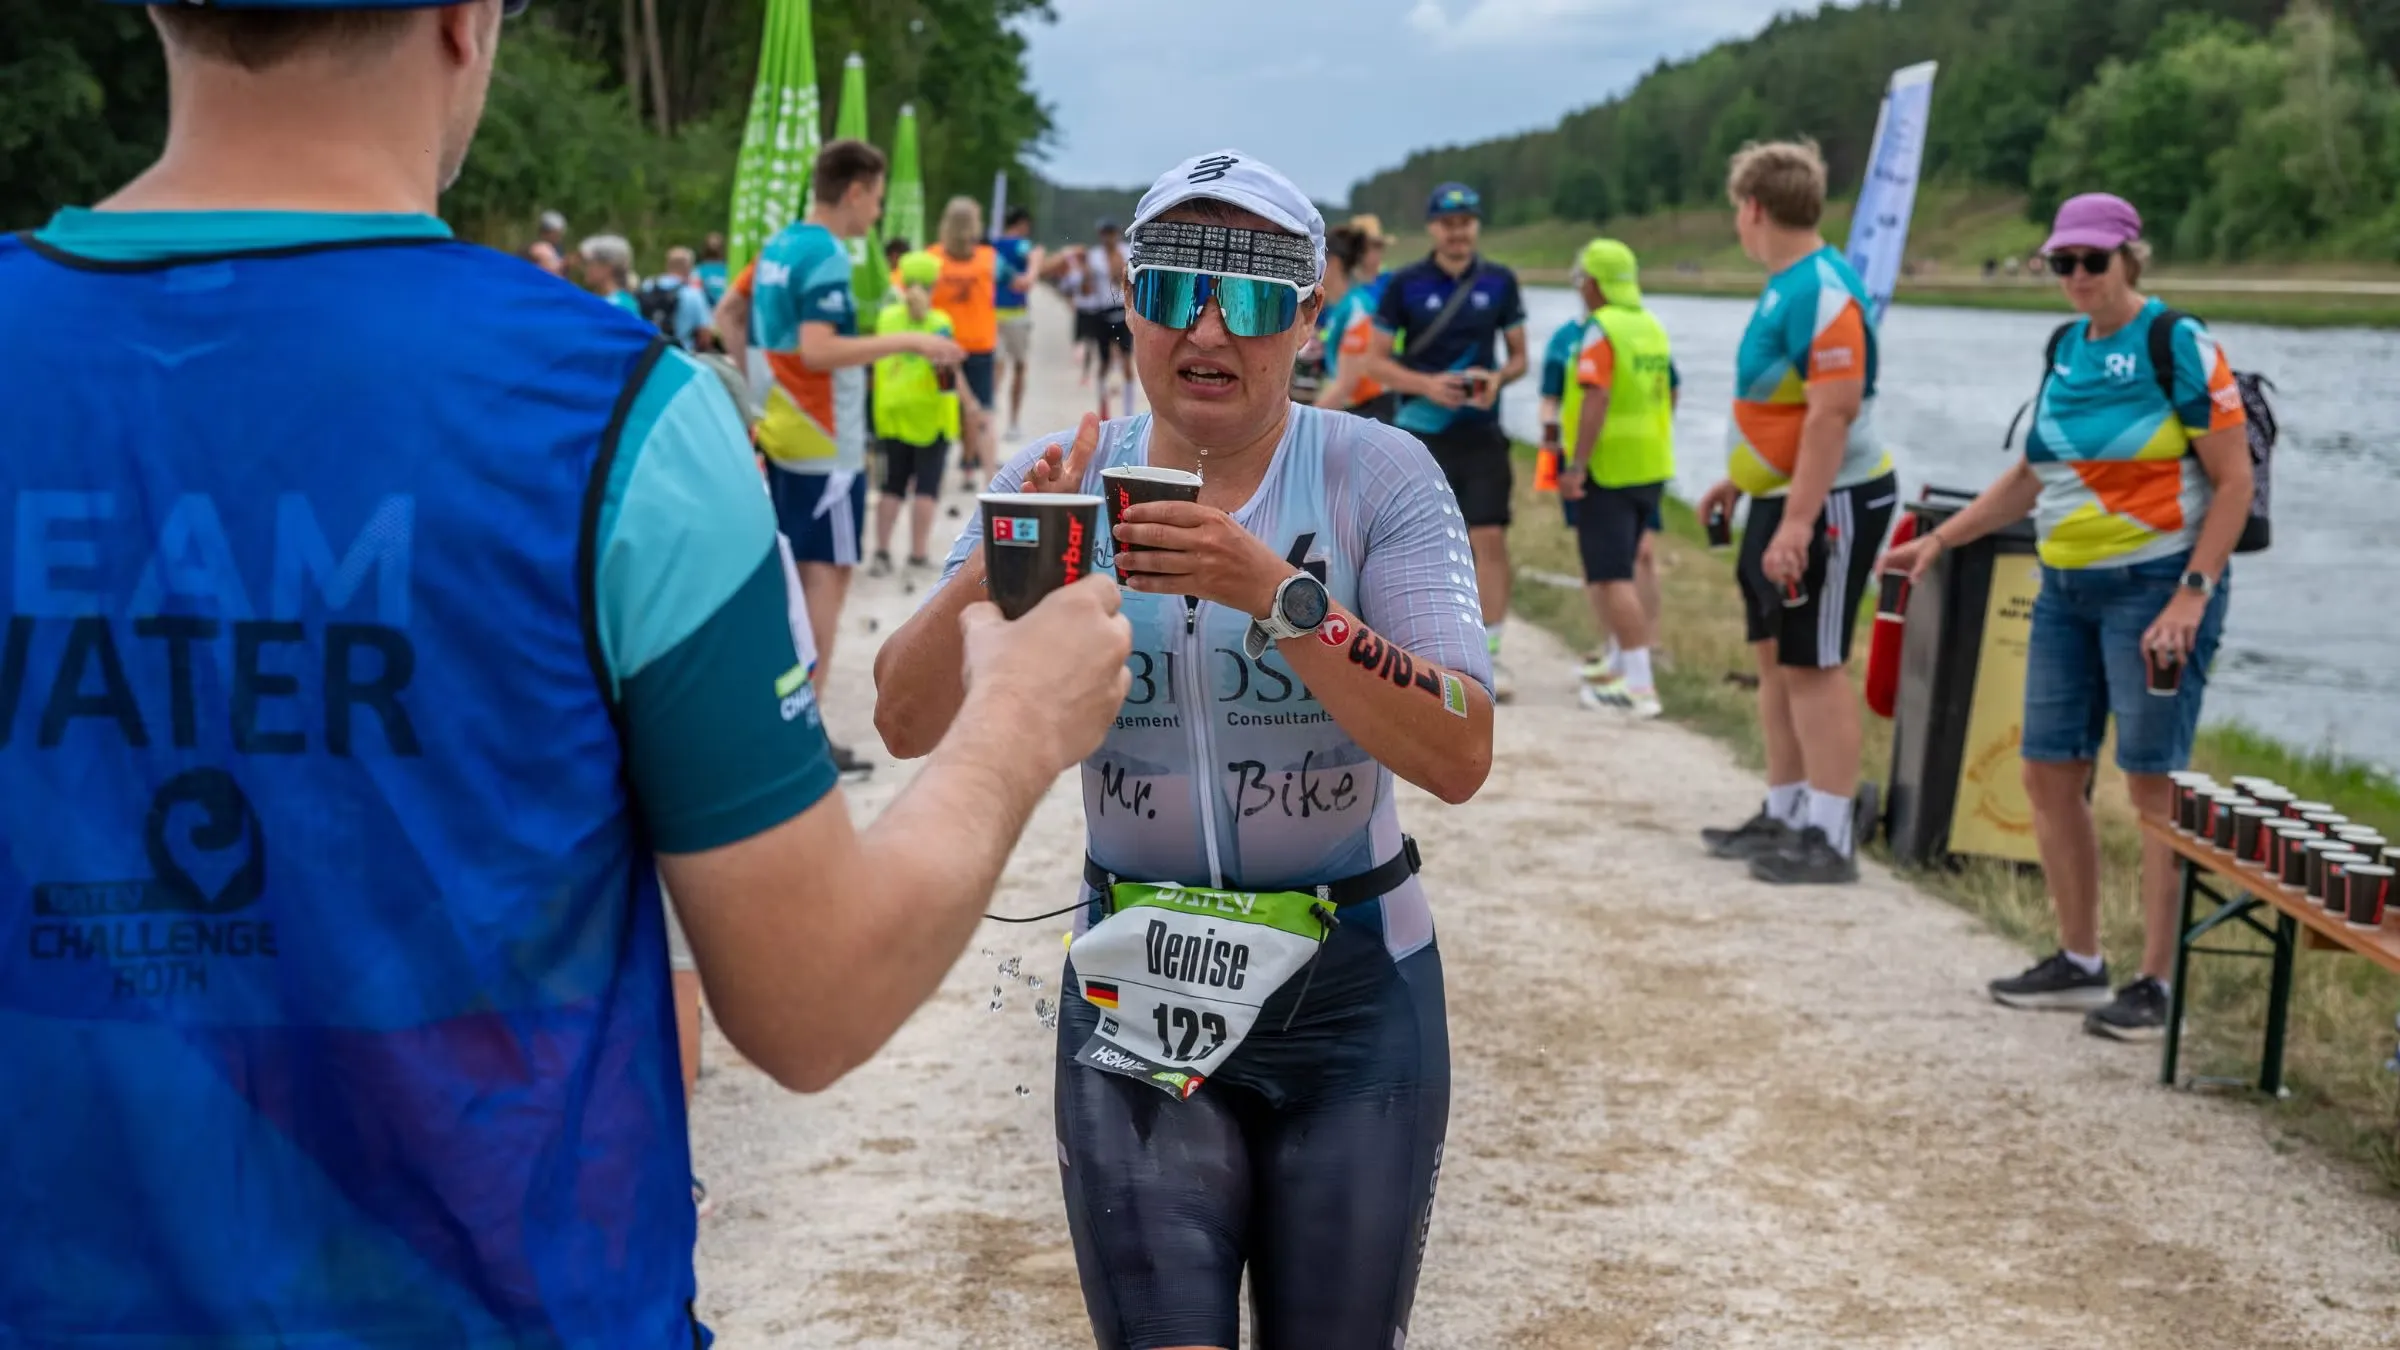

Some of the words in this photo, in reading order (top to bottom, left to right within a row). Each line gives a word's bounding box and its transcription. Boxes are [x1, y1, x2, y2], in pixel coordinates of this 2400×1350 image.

[11, 490, 416, 628] EAM
[1348, 627, 1442, 700] 123
[1113, 714, 1181, 729] gement
[1100, 760, 1156, 820] Mr.
[1227, 750, 1358, 824] Bike
[29, 920, 279, 962] CHALLENGE
[1145, 918, 1249, 991] Denise
[1103, 1020, 1118, 1033] PRO
[1152, 1003, 1227, 1062] 123
